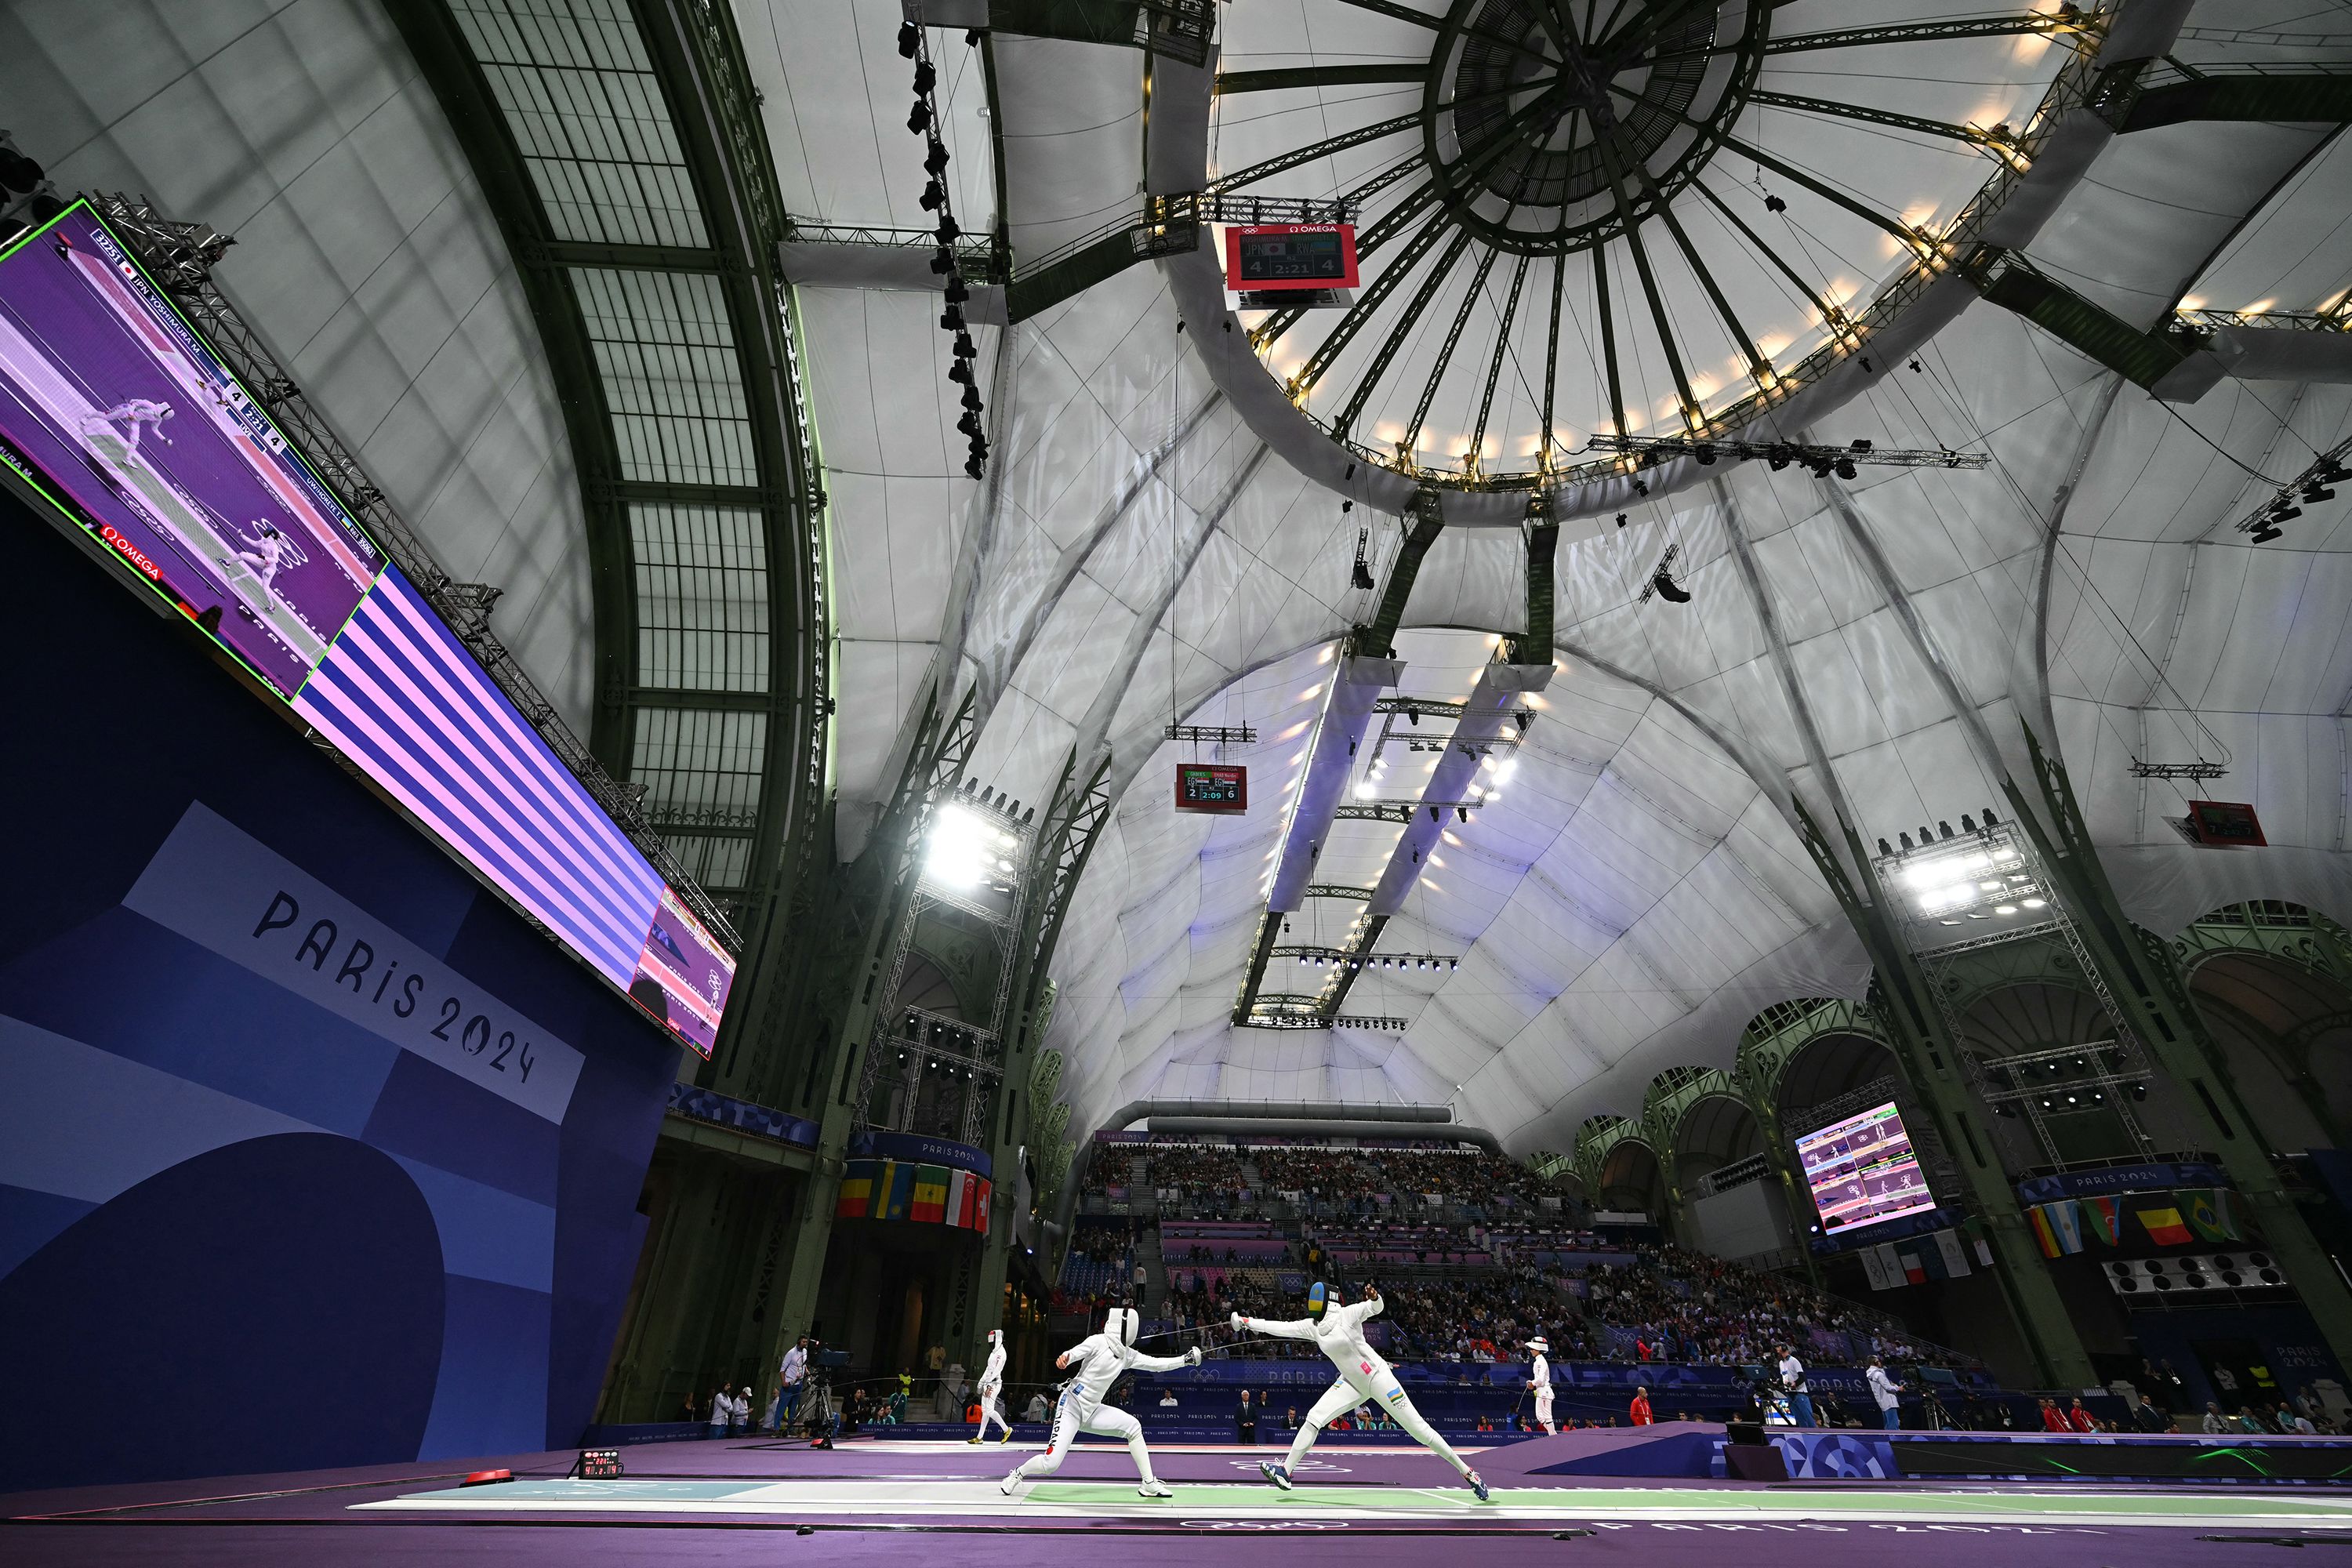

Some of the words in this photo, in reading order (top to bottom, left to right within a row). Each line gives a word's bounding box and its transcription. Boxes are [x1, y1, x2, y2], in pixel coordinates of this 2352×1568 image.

[96, 234, 122, 263] 32251
[1245, 244, 1263, 255] JPN
[1297, 243, 1315, 253] RWA
[1250, 261, 1262, 272] 4
[1276, 264, 1309, 274] 2:21
[1322, 260, 1334, 270] 4
[133, 278, 149, 295] JPN
[149, 295, 191, 344] YOSHIMURA
[232, 392, 241, 401] 4
[245, 410, 263, 431] 2:21
[239, 423, 252, 437] LIVE
[271, 437, 280, 446] 4
[307, 477, 338, 513] UWIHOREYE
[117, 539, 158, 579] OMEGA
[430, 996, 535, 1083] 2024
[923, 1144, 951, 1156] PARIS
[955, 1150, 975, 1162] 2024
[2077, 1175, 2115, 1186] PARIS
[2120, 1172, 2157, 1181] 2024
[2276, 1347, 2321, 1356] PARIS
[1048, 1409, 1063, 1446] JAPAN
